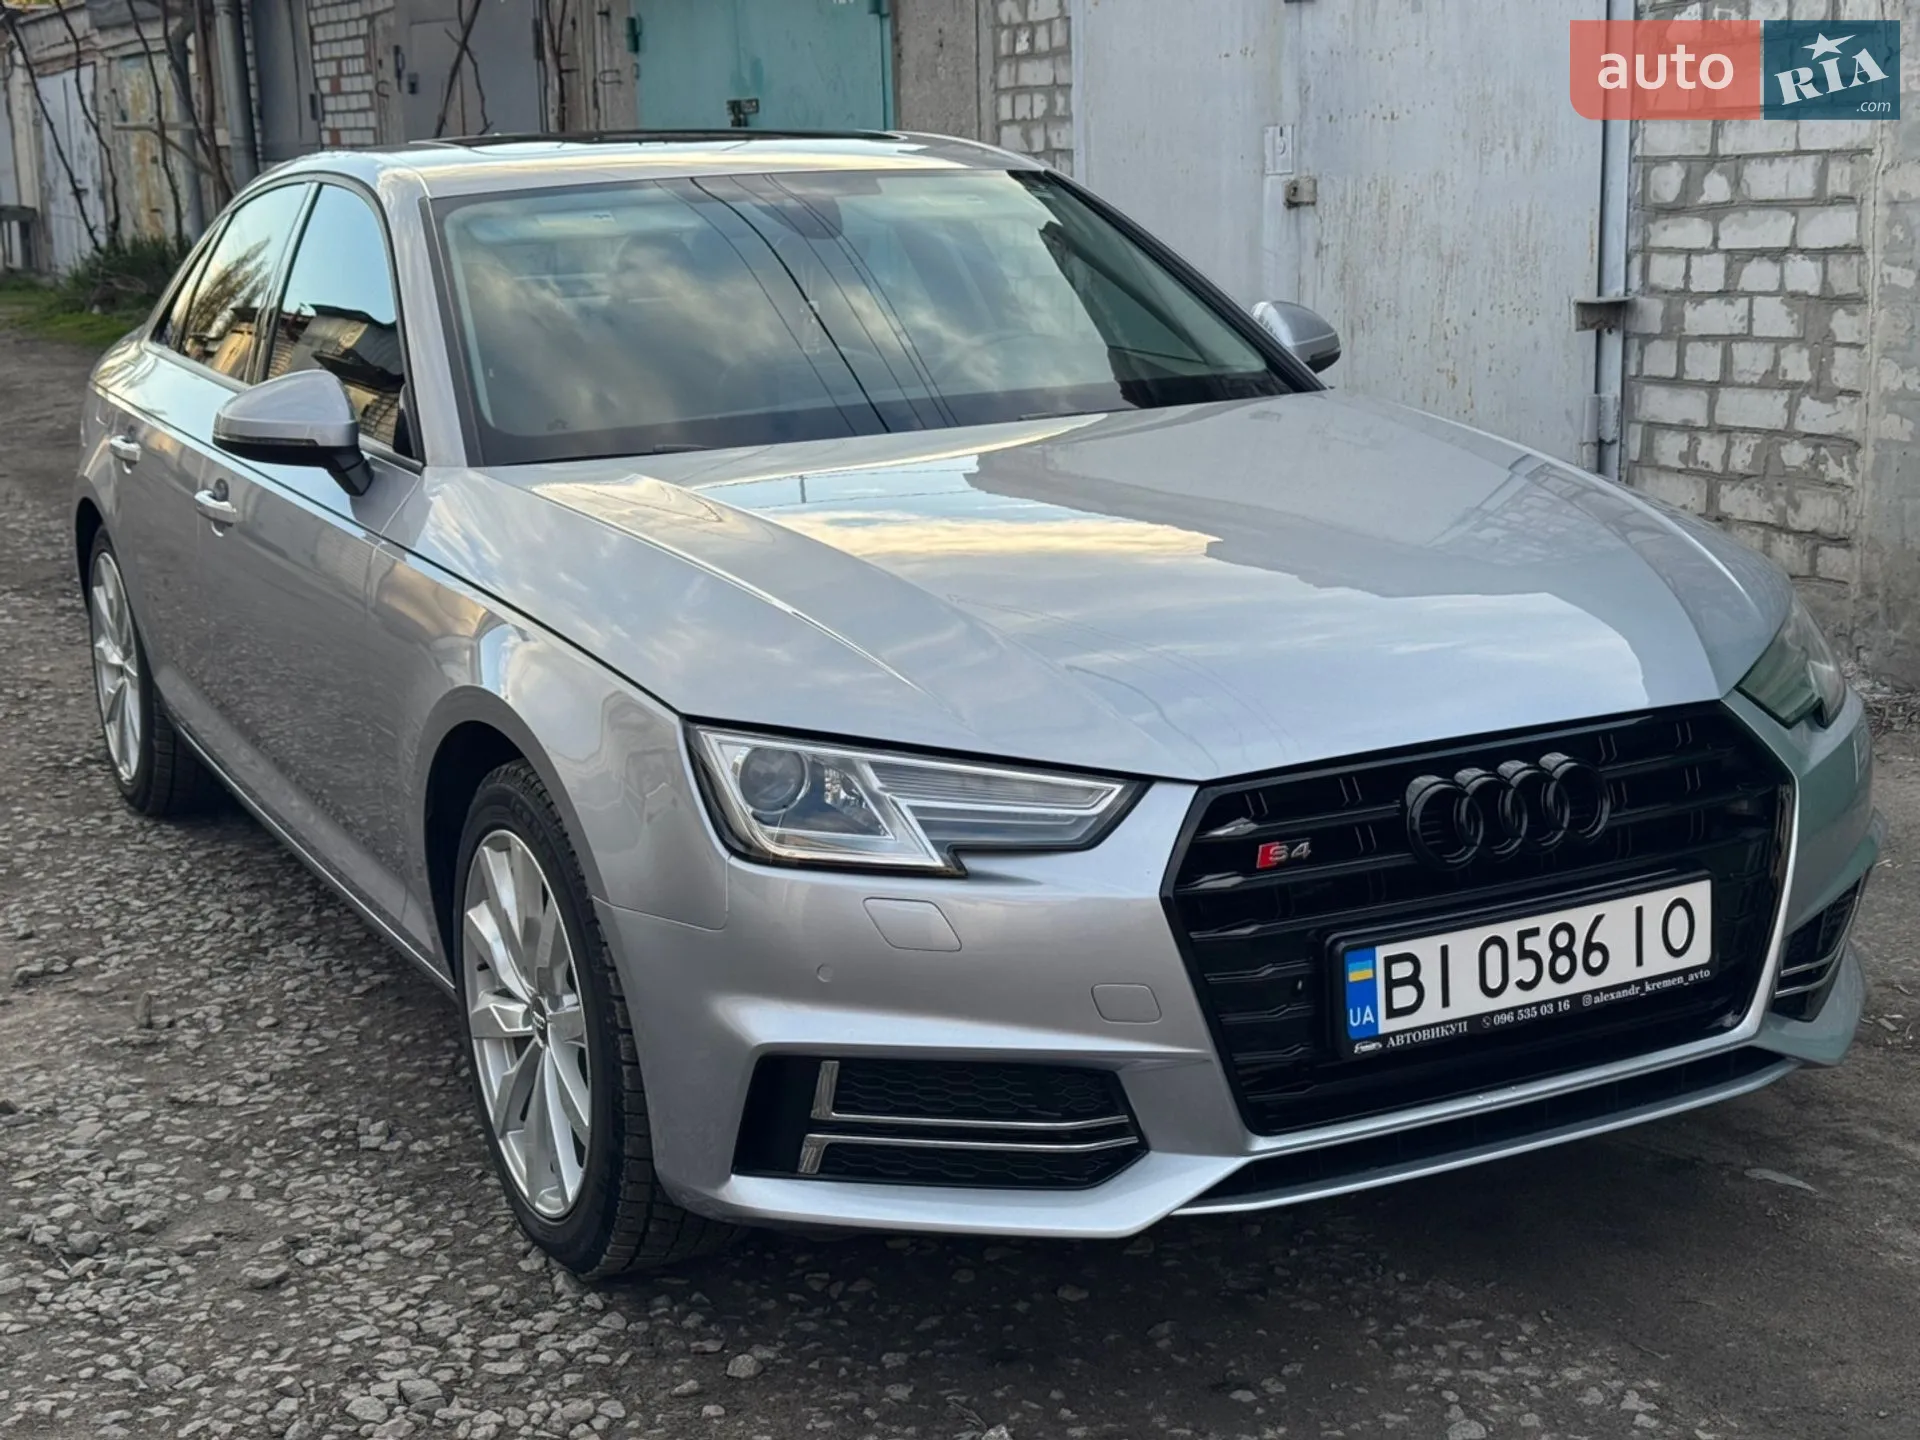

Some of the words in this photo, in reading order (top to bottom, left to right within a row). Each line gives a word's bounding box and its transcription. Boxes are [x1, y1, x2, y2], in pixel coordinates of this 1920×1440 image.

[1267, 841, 1312, 861] S4
[1383, 944, 1450, 1020] BI
[1478, 913, 1610, 999] 0586
[1634, 896, 1696, 968] IO
[1349, 1005, 1375, 1027] UA
[1493, 1011, 1515, 1026] 096
[1517, 1006, 1538, 1021] 535
[1540, 1002, 1554, 1016] 03
[1557, 999, 1571, 1012] 16
[1386, 1020, 1469, 1048] АВТОВИКУП
